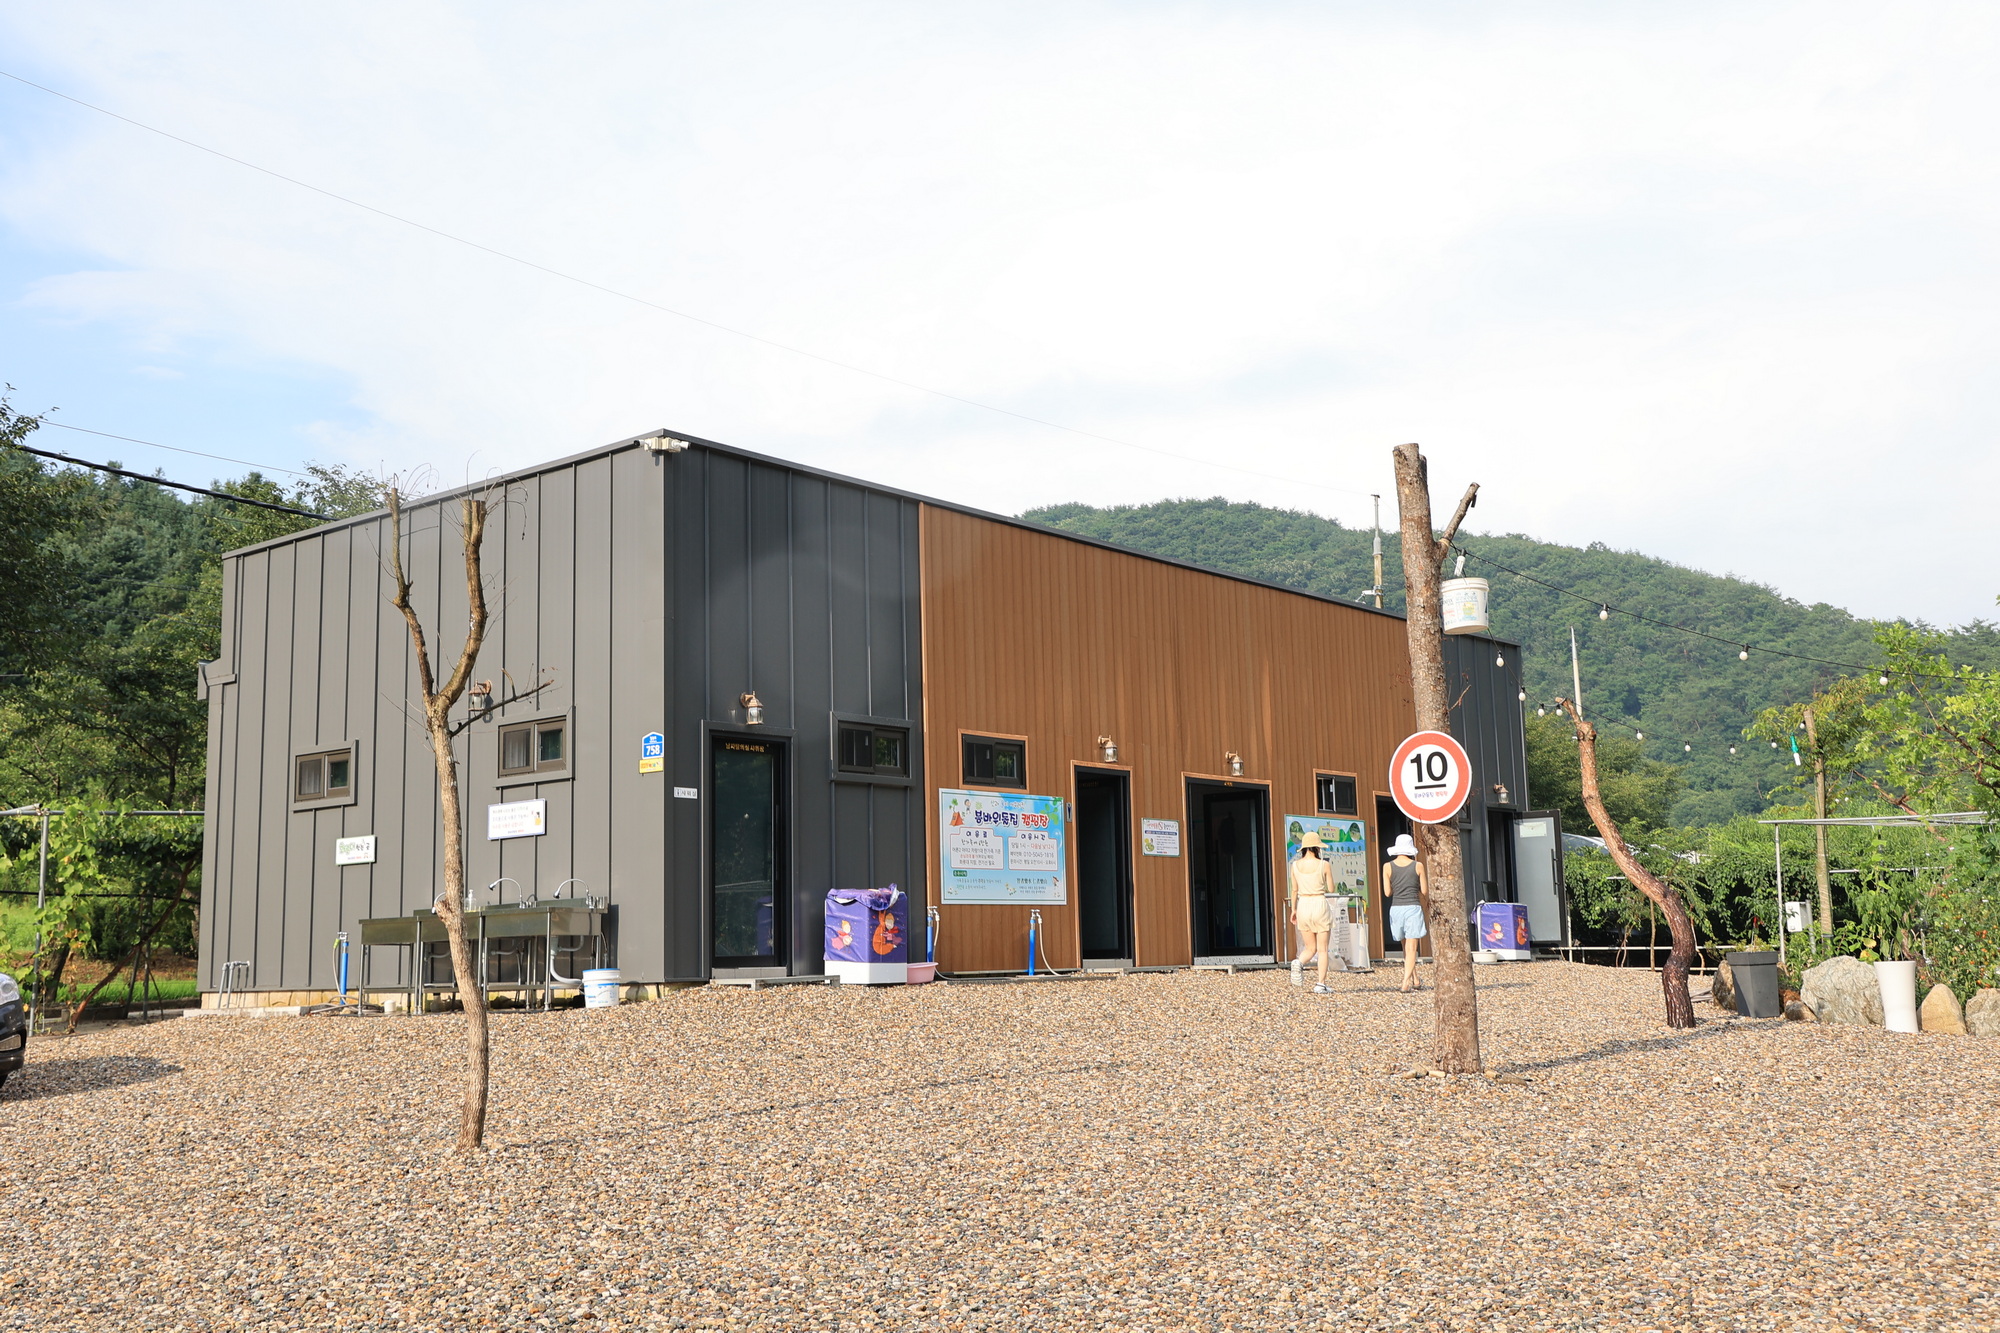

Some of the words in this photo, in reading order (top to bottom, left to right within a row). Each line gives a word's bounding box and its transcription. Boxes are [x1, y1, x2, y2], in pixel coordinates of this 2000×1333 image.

[646, 745, 660, 756] 758
[1410, 751, 1448, 783] 10
[1021, 813, 1048, 827] 캠핑장
